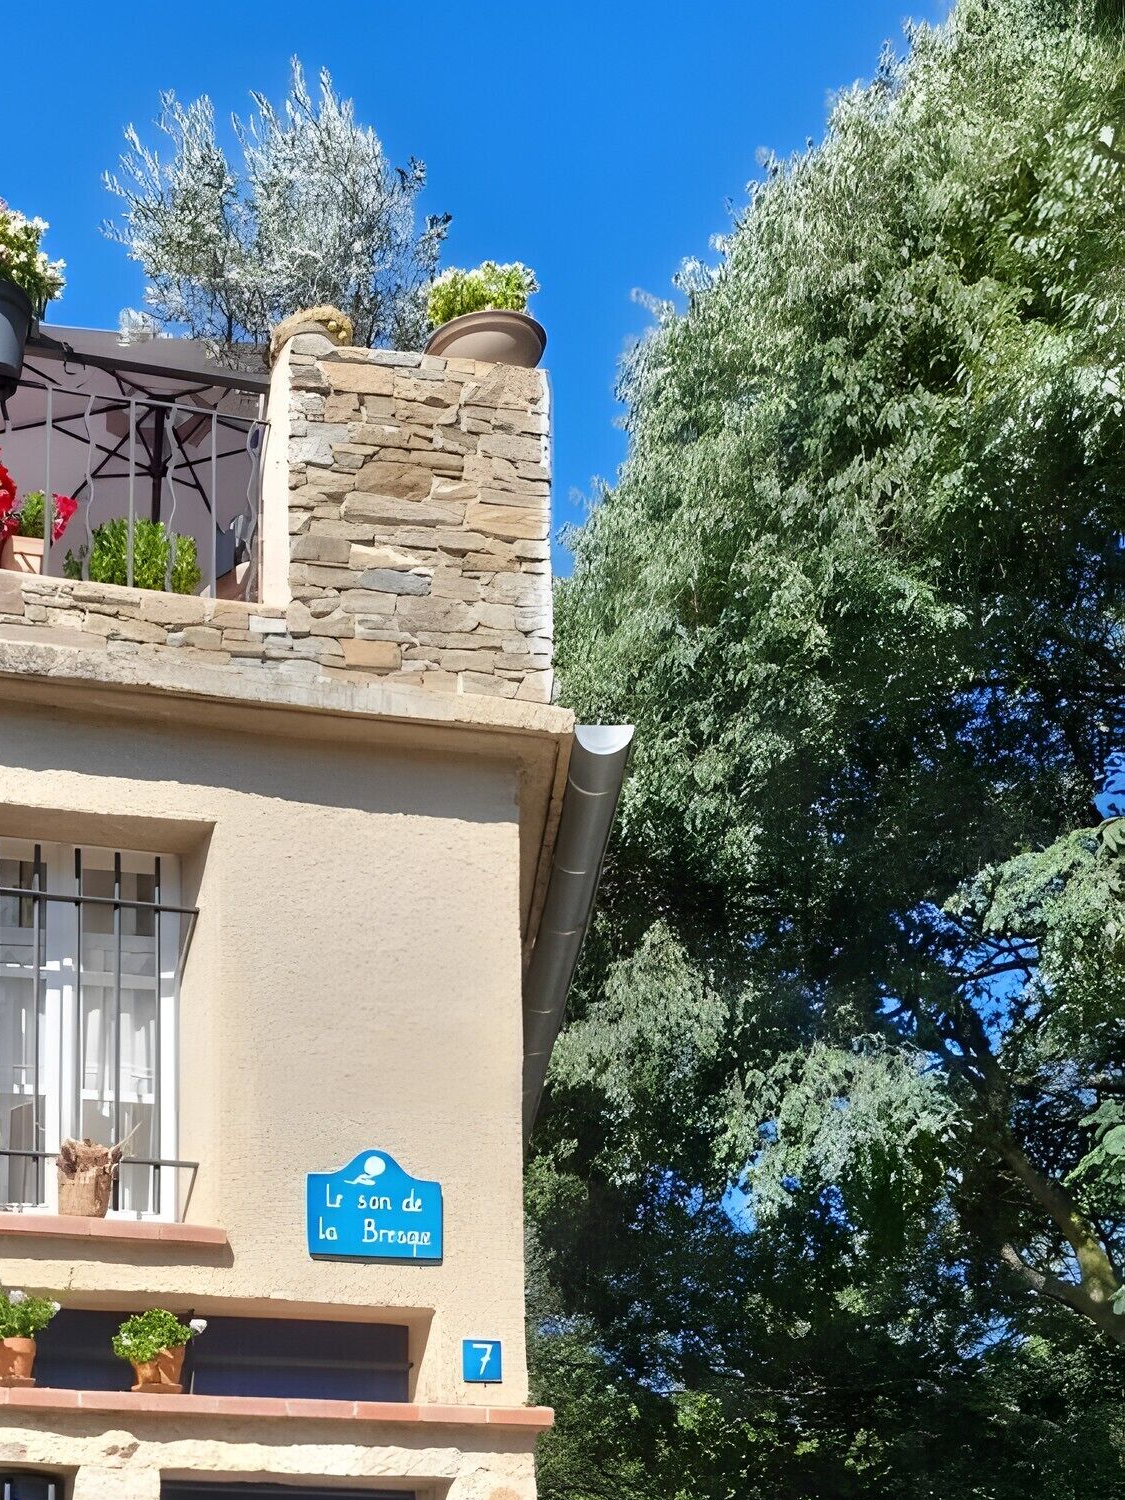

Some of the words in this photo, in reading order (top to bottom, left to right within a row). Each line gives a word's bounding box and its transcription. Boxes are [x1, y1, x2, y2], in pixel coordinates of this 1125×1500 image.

[357, 1194, 392, 1211] son
[401, 1187, 423, 1212] de
[472, 1343, 493, 1376] 7
